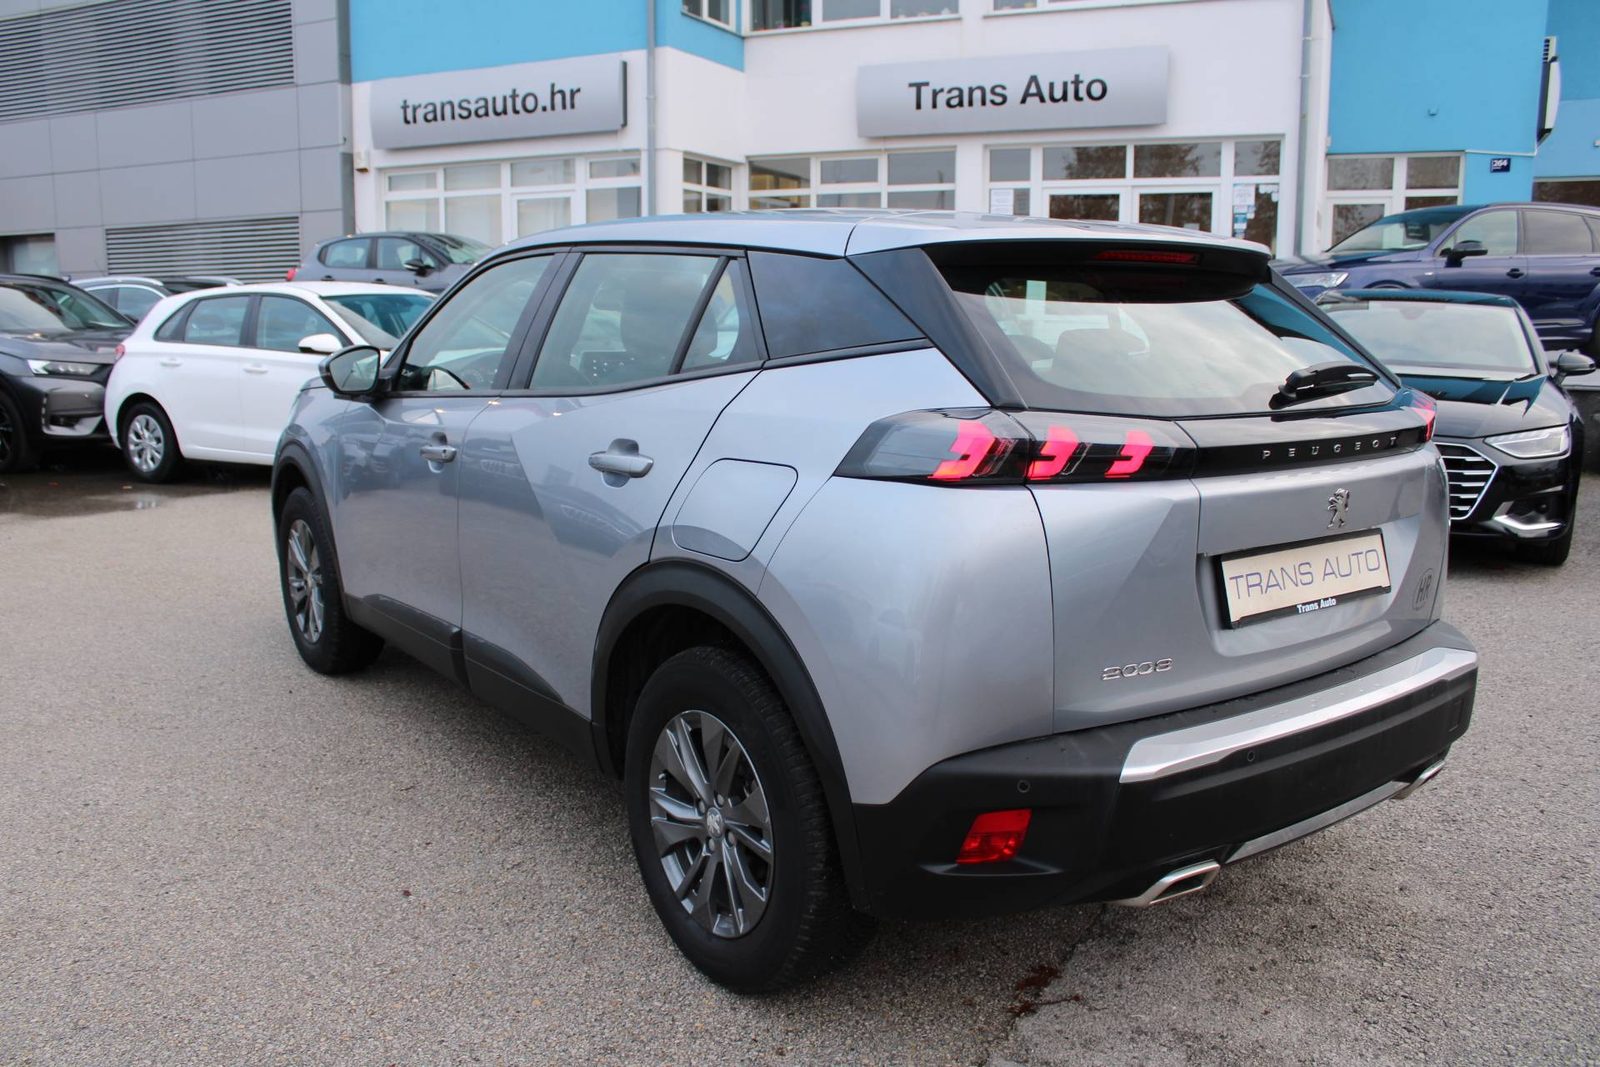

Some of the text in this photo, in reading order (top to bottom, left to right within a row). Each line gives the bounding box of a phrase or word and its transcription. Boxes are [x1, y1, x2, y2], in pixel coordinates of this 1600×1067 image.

[401, 82, 581, 125] transauto.hr
[908, 73, 1108, 110] Trans Auto
[1262, 436, 1397, 460] PEUGEOT
[1229, 548, 1381, 600] TRANS AUTO
[1296, 597, 1337, 614] Trans Auto
[1102, 657, 1173, 680] 2008
